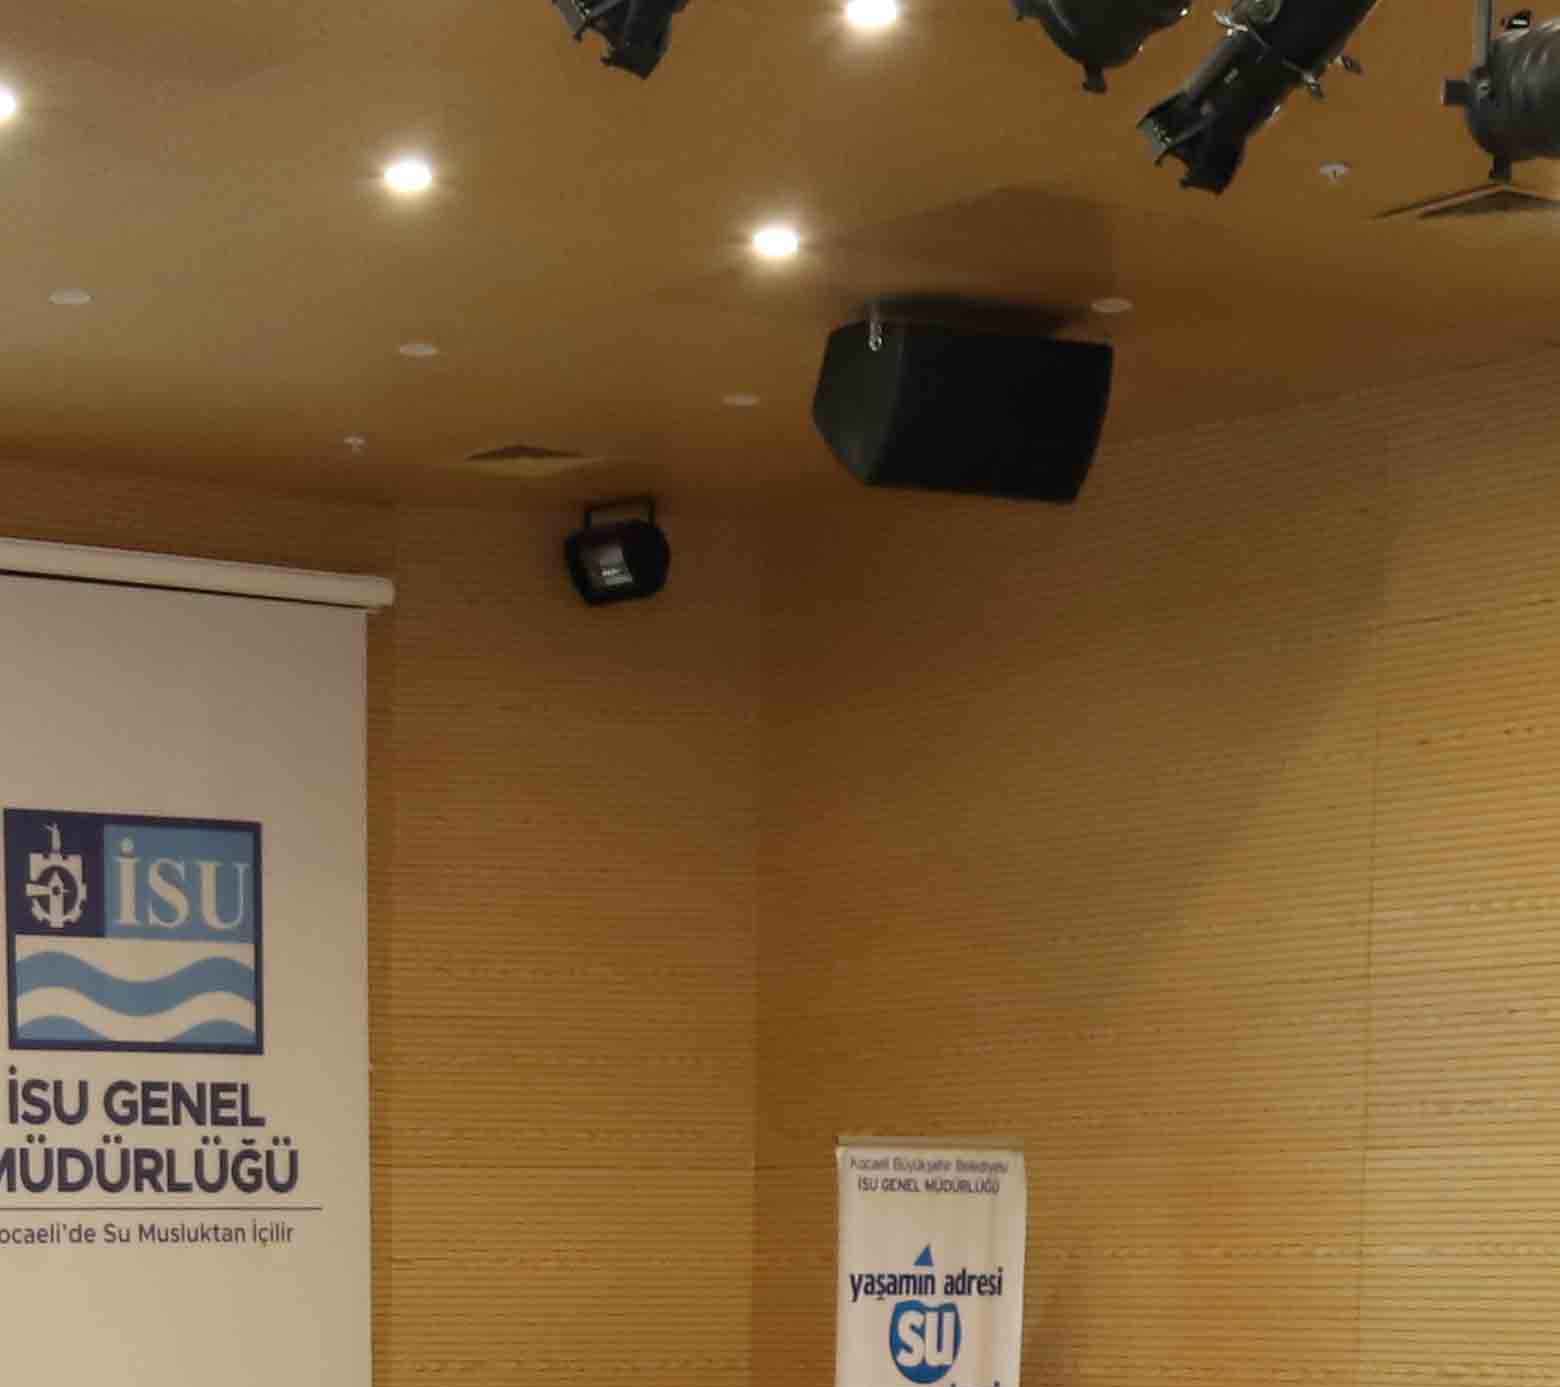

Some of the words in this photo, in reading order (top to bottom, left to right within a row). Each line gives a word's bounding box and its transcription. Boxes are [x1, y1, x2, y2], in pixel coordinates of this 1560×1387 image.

[113, 836, 252, 930] İSU
[8, 1065, 88, 1125] İSU
[103, 1079, 266, 1127] GENEL
[882, 1177, 920, 1192] GENEL
[104, 1224, 131, 1245] Su
[138, 1223, 246, 1245] Musluktan
[943, 1267, 1004, 1297] adresi
[897, 1311, 957, 1366] SU
